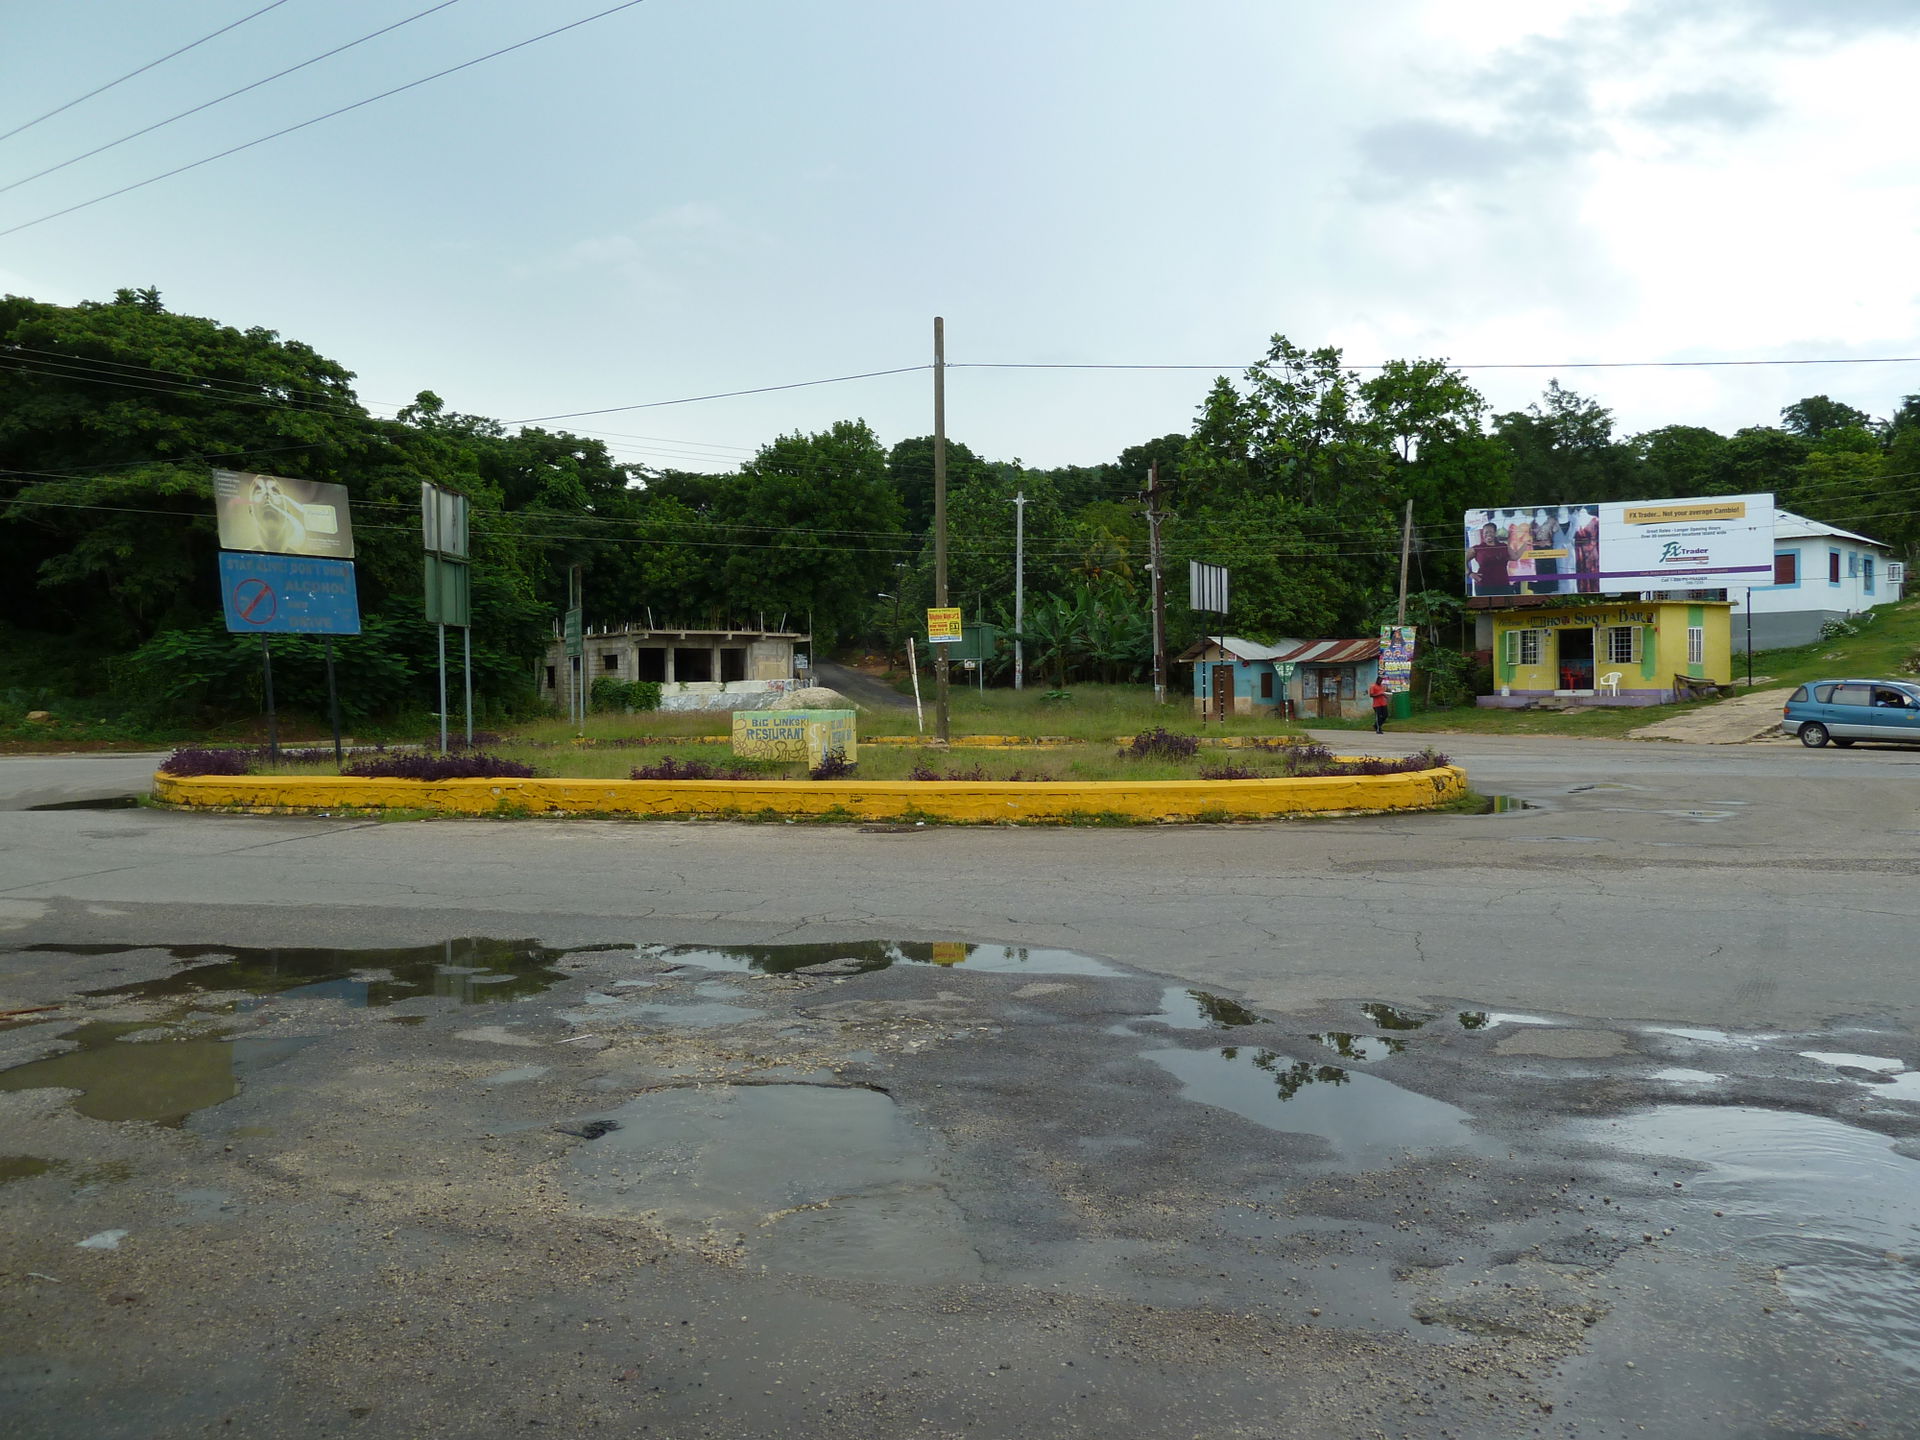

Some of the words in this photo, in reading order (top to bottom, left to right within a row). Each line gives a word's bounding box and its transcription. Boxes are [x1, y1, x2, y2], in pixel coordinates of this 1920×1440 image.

[1714, 506, 1740, 514] Cambio!
[1680, 547, 1709, 555] Trader
[285, 580, 348, 593] ALCOHOL
[1618, 609, 1647, 624] BAR
[746, 727, 805, 740] RESTURANT
